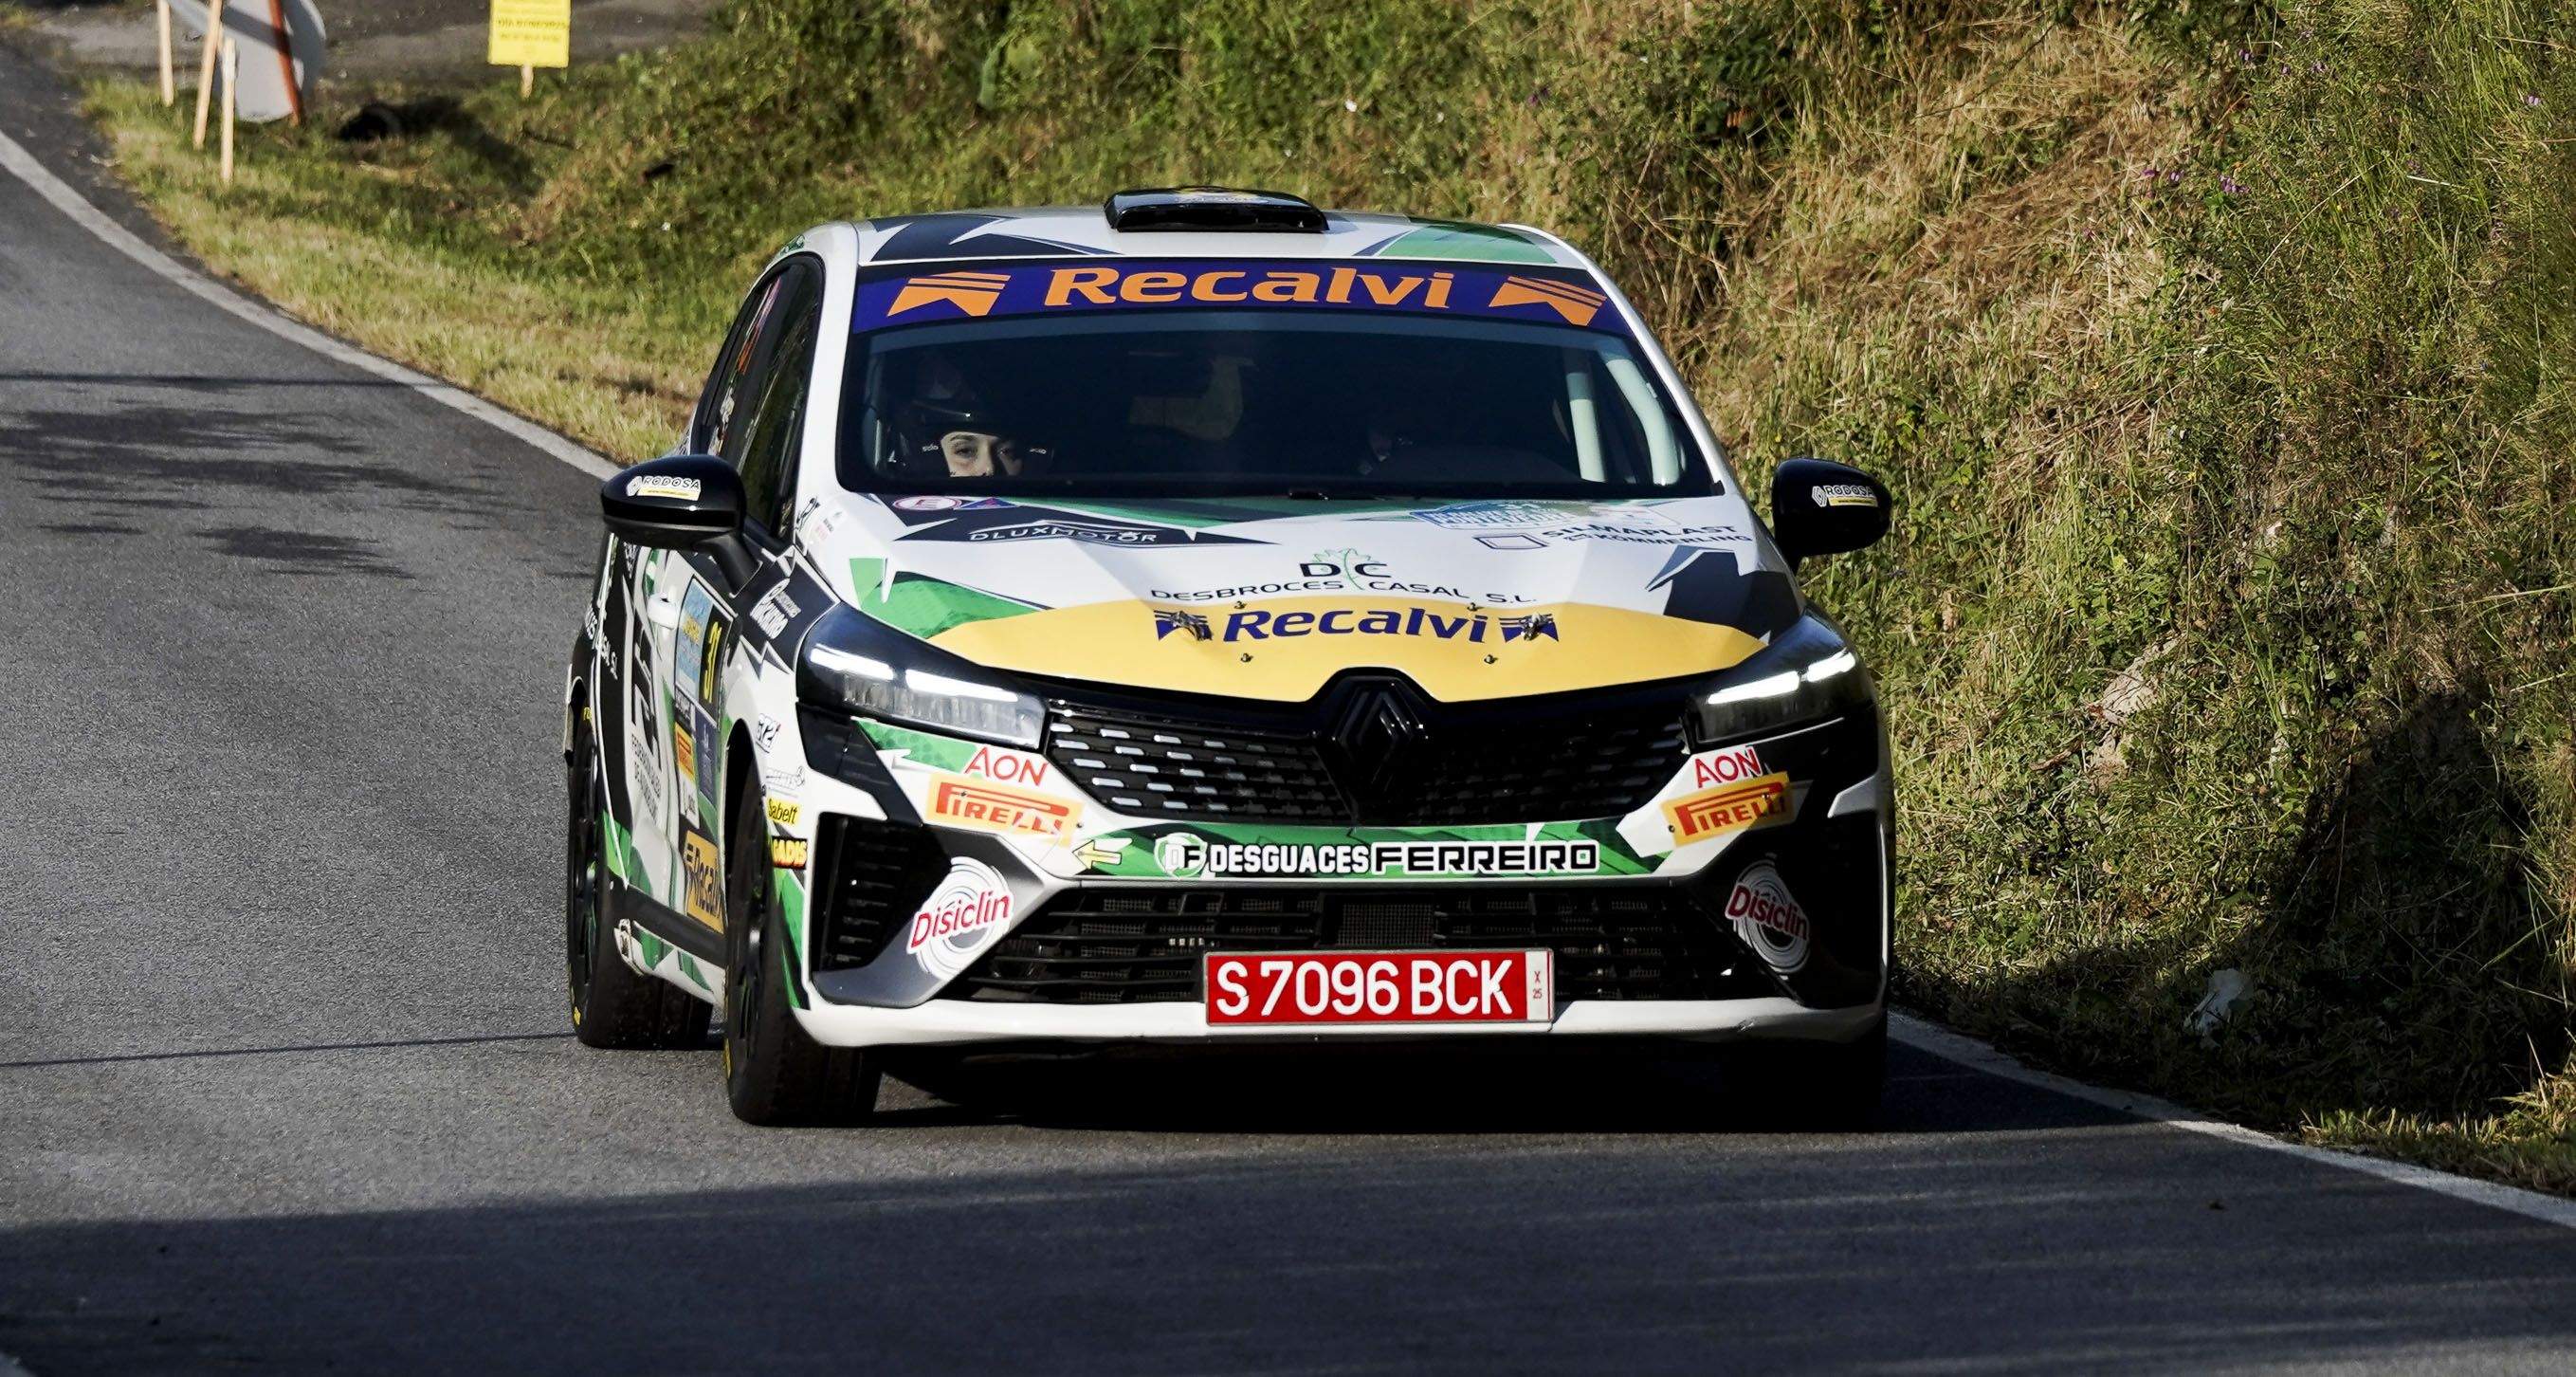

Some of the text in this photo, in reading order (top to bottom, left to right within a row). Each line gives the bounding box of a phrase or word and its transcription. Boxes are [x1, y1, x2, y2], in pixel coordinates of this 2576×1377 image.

[1044, 266, 1458, 309] Recalvi
[643, 476, 701, 489] RODOSA
[1825, 486, 1875, 496] RODOSA
[969, 526, 1158, 542] DLUXMOTOR
[1542, 523, 1738, 538] SILMAPLAST
[1151, 580, 1537, 604] DESBROCES CASAL S.L.
[1223, 607, 1489, 643] Recalvi
[964, 747, 1050, 787] AON
[1694, 746, 1763, 788] AON
[768, 799, 797, 824] Sabelt
[936, 781, 1070, 835] PIRELLI
[1673, 781, 1787, 837] PIRELLI
[1210, 844, 1369, 873] DESGUACES
[1373, 842, 1599, 873] FERREIRO
[911, 890, 1012, 948] Disiclin
[1726, 885, 1809, 941] Disiclin
[1215, 959, 1513, 1017] S 7096 BCK
[1532, 989, 1544, 1001] 25
